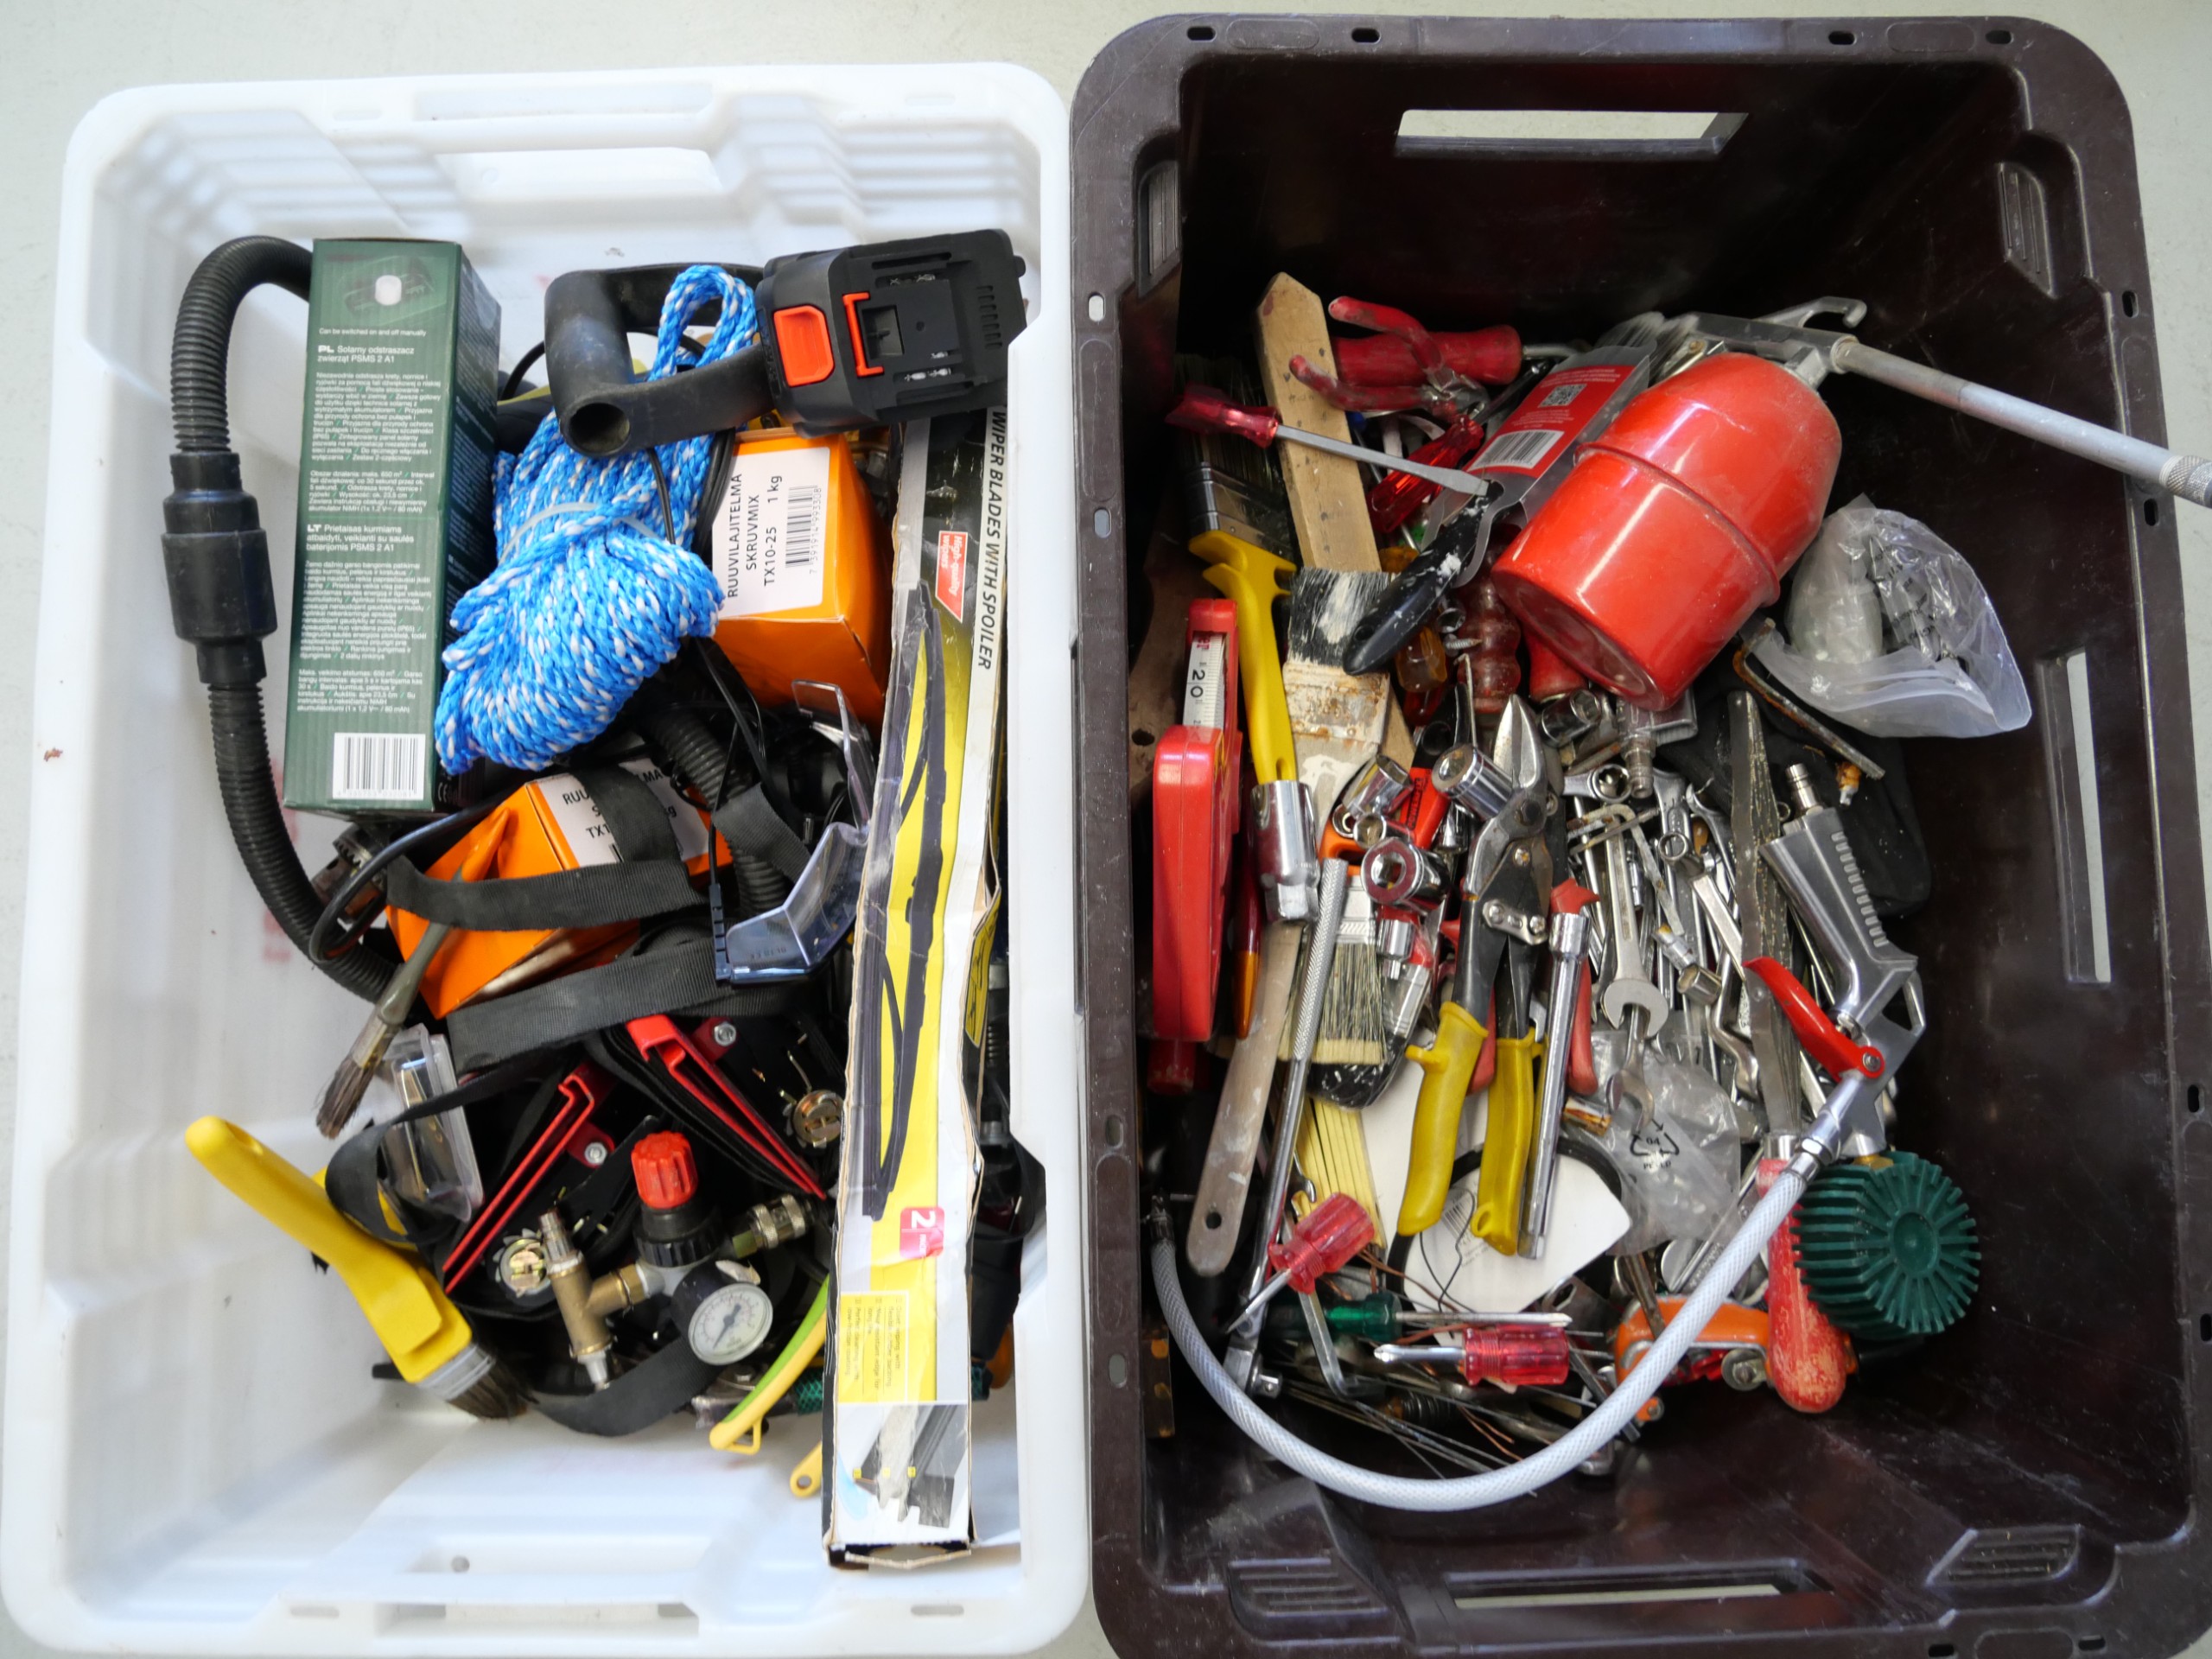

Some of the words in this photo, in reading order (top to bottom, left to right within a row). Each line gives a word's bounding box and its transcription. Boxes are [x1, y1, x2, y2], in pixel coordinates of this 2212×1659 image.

[317, 345, 334, 353] PL
[368, 346, 414, 354] odstraszacz
[350, 353, 376, 362] PSMS
[376, 354, 383, 363] 2
[384, 354, 394, 363] A1
[989, 410, 1006, 465] WIPER
[767, 475, 783, 492] kg
[985, 470, 1003, 538] BLADES
[305, 543, 348, 551] baterijomis
[349, 543, 375, 551] PSMS
[376, 543, 382, 552] 2
[383, 543, 394, 551] A1
[306, 523, 321, 532] LT
[323, 524, 362, 532] Prietaisas
[363, 524, 402, 533] kurmiams
[306, 533, 342, 542] atbaidyti,
[728, 474, 742, 598] RUUVILAJITELMA
[746, 495, 760, 570] SKRUVMIX
[764, 526, 777, 587] TX10-25
[941, 535, 951, 569] wipers
[948, 536, 963, 596] High-quality
[980, 543, 999, 589] WITH
[977, 590, 998, 670] SPOILER
[912, 1211, 936, 1230] 2
